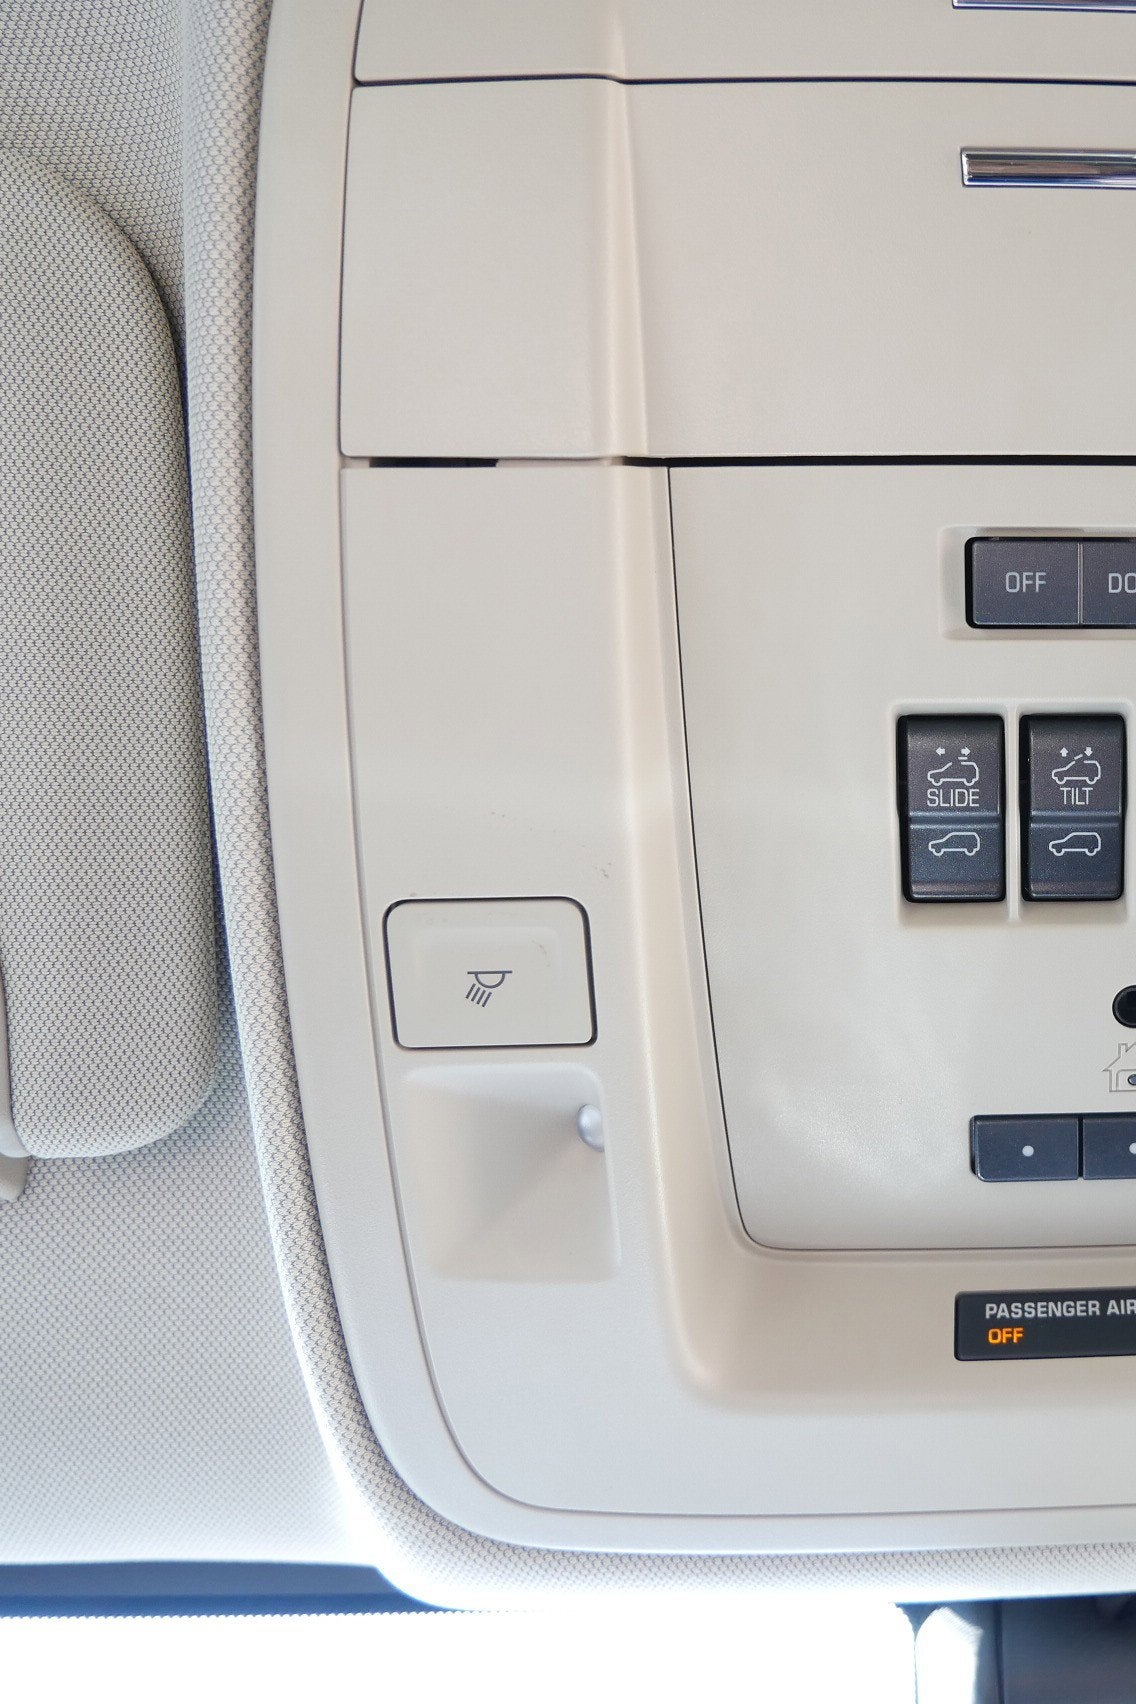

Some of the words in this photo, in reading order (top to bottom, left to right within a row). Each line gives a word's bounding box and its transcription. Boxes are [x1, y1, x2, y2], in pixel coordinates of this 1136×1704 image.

[1005, 572, 1047, 593] OFF
[926, 788, 980, 807] SLIDE
[1060, 787, 1094, 805] TILT
[985, 1301, 1100, 1319] PASSENGER
[988, 1327, 1024, 1344] OFF
